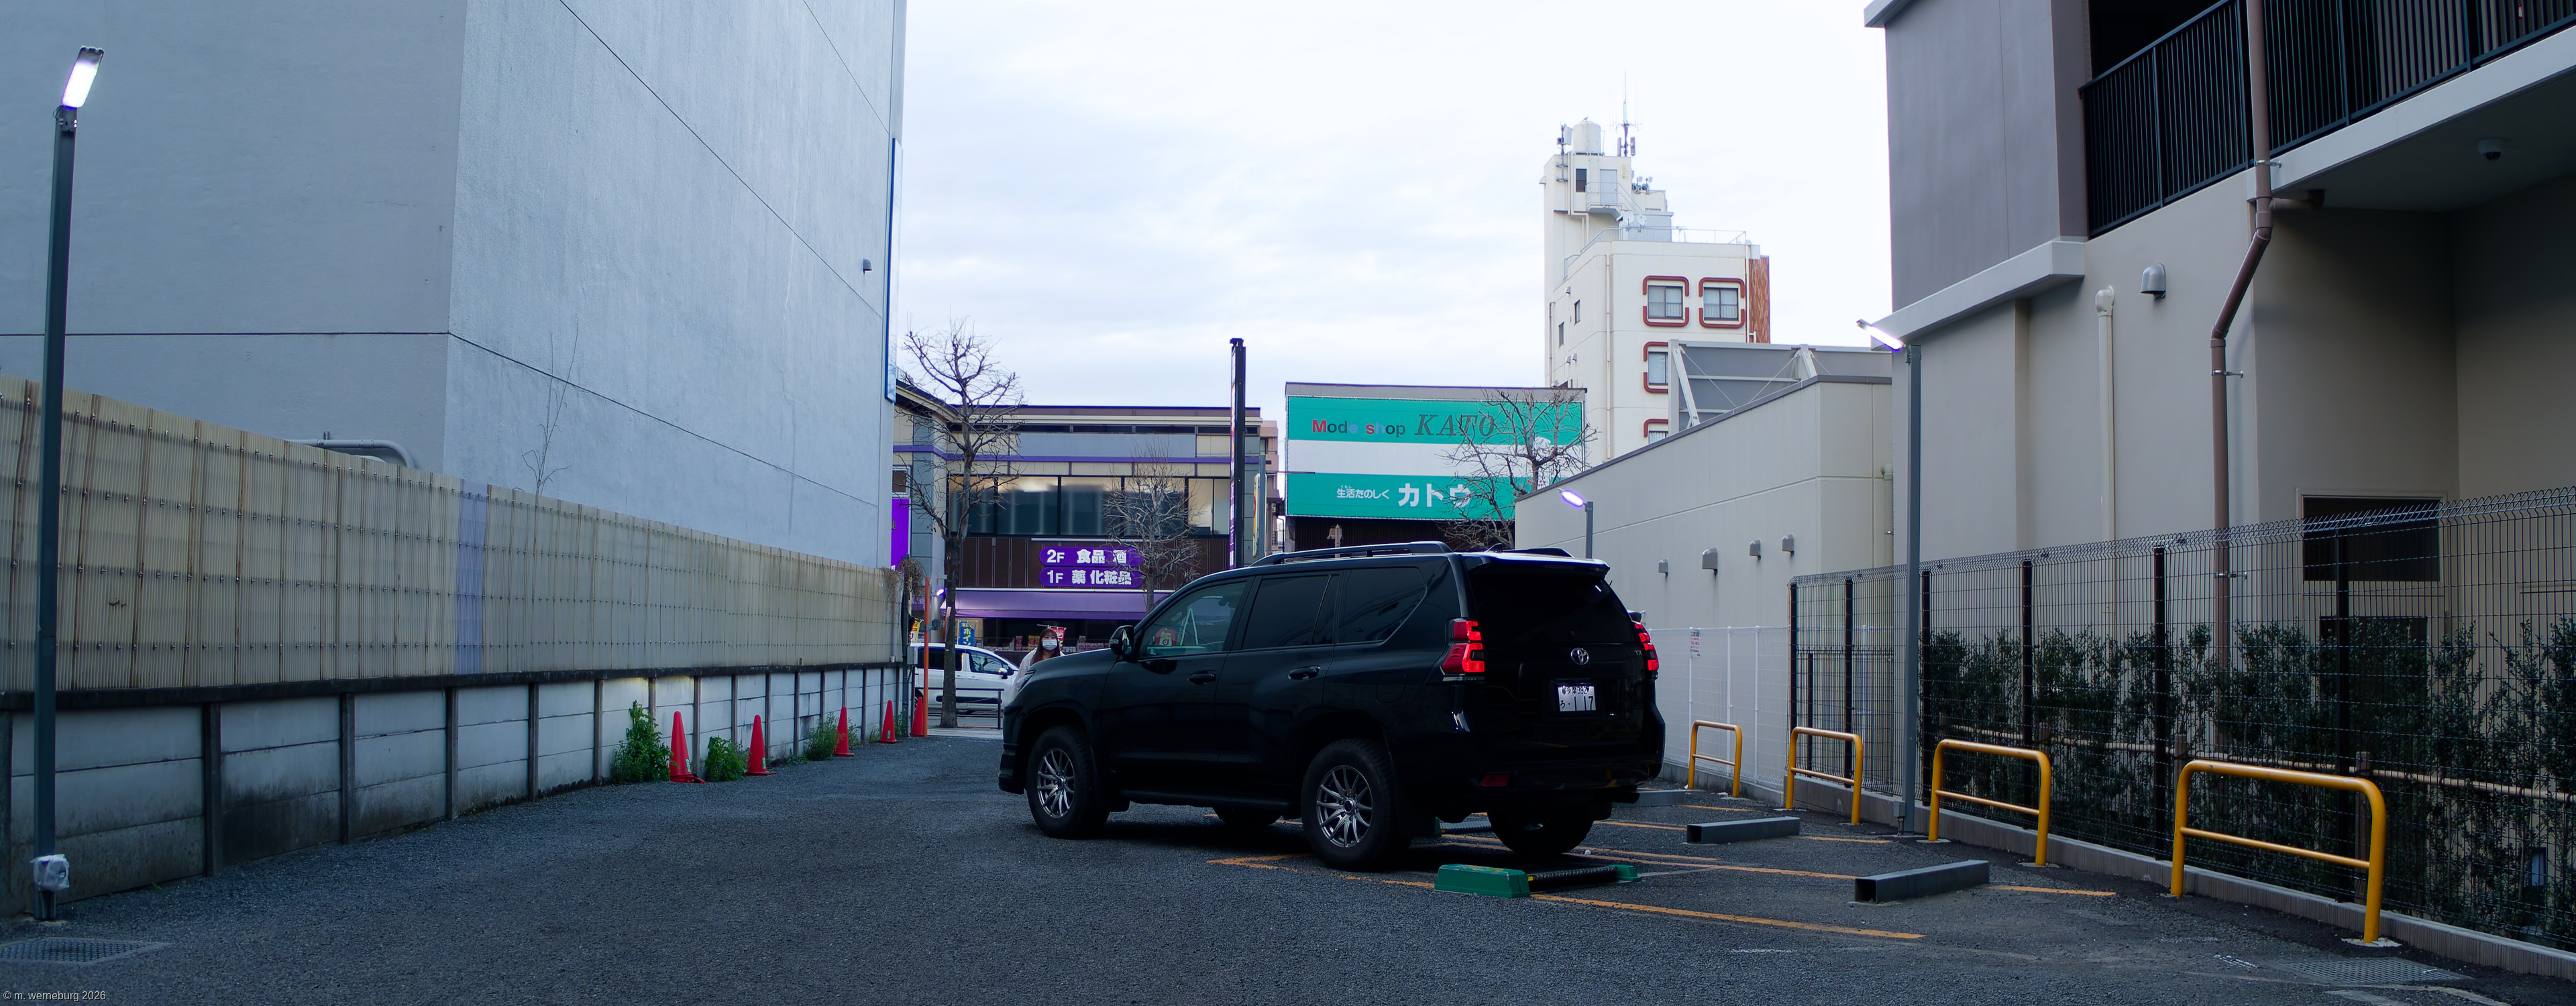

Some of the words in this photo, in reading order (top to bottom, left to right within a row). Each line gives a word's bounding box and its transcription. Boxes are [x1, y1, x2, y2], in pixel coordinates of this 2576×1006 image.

[1312, 419, 1358, 434] Mode
[1366, 422, 1406, 437] shop
[1414, 414, 1495, 437] KATO
[1336, 488, 1389, 499] 生活たのしく
[1398, 483, 1471, 508] カトウ
[1046, 549, 1065, 563] 2F
[1077, 549, 1105, 564] 食品
[1113, 549, 1127, 564] 酒
[1047, 570, 1063, 583] 1F
[1072, 570, 1086, 584] 薬
[1090, 570, 1132, 585] 化粧品
